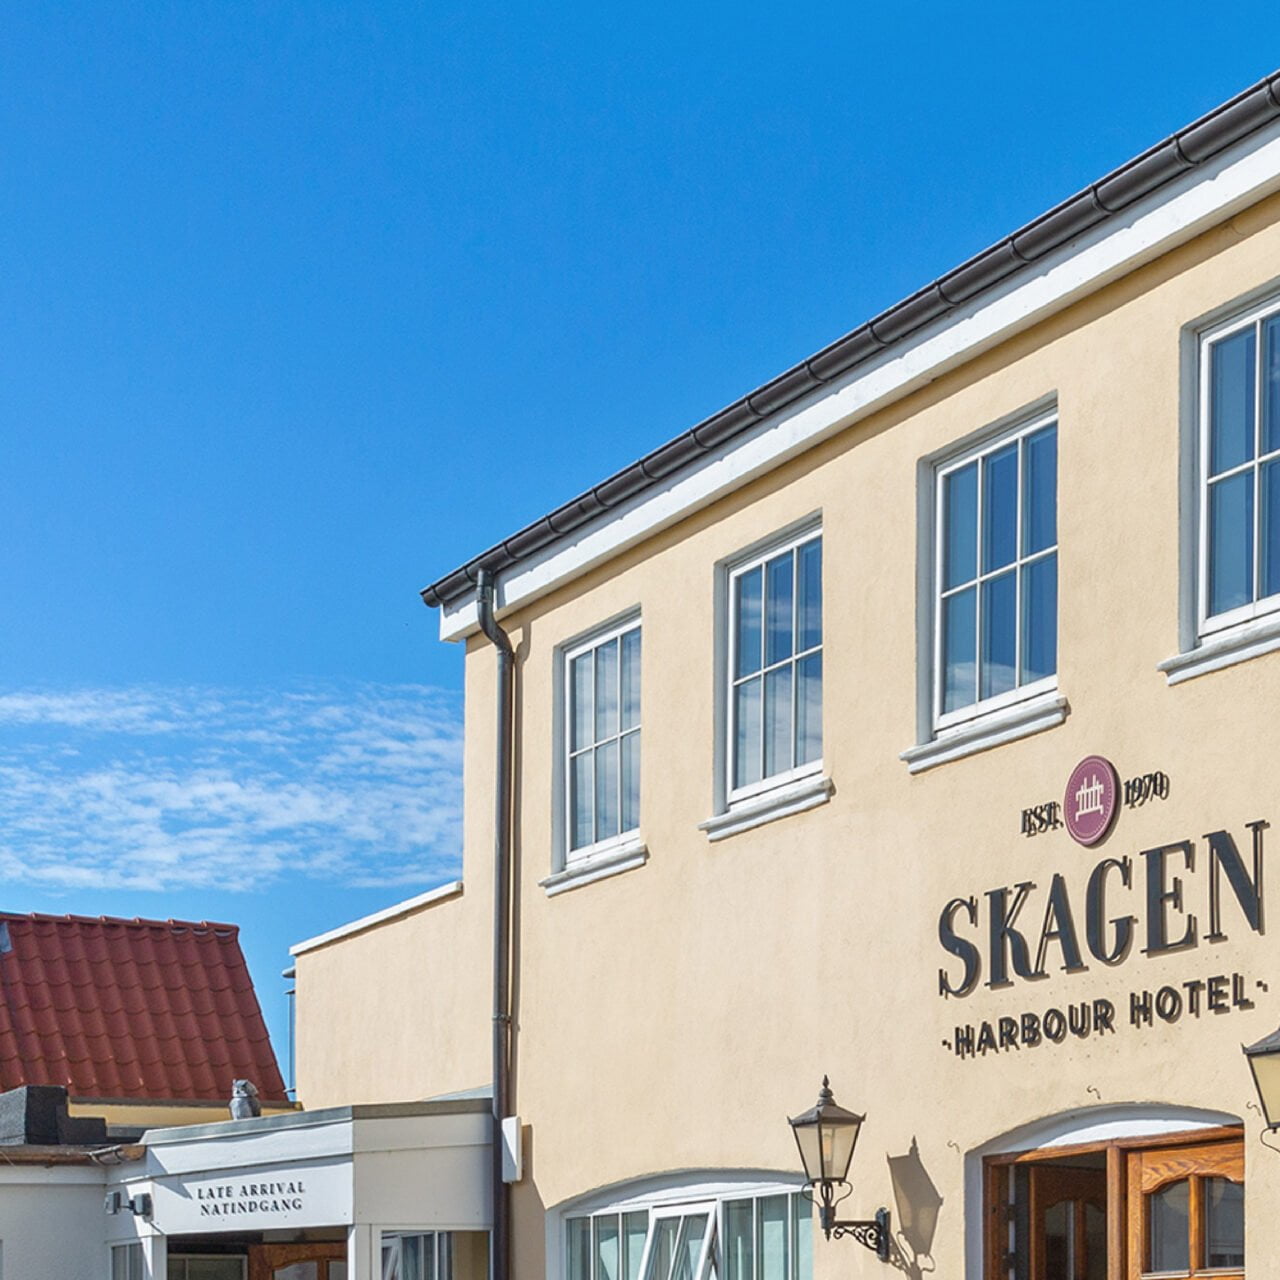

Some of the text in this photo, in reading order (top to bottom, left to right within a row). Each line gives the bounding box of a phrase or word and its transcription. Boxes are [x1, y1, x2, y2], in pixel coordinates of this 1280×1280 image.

[1123, 771, 1167, 806] 1970
[938, 820, 1267, 998] SKAGEN
[954, 972, 1253, 1058] HARBOUR HOTEL
[197, 1181, 305, 1200] LATE ARRIVAL
[200, 1198, 302, 1216] NATINDGANG
